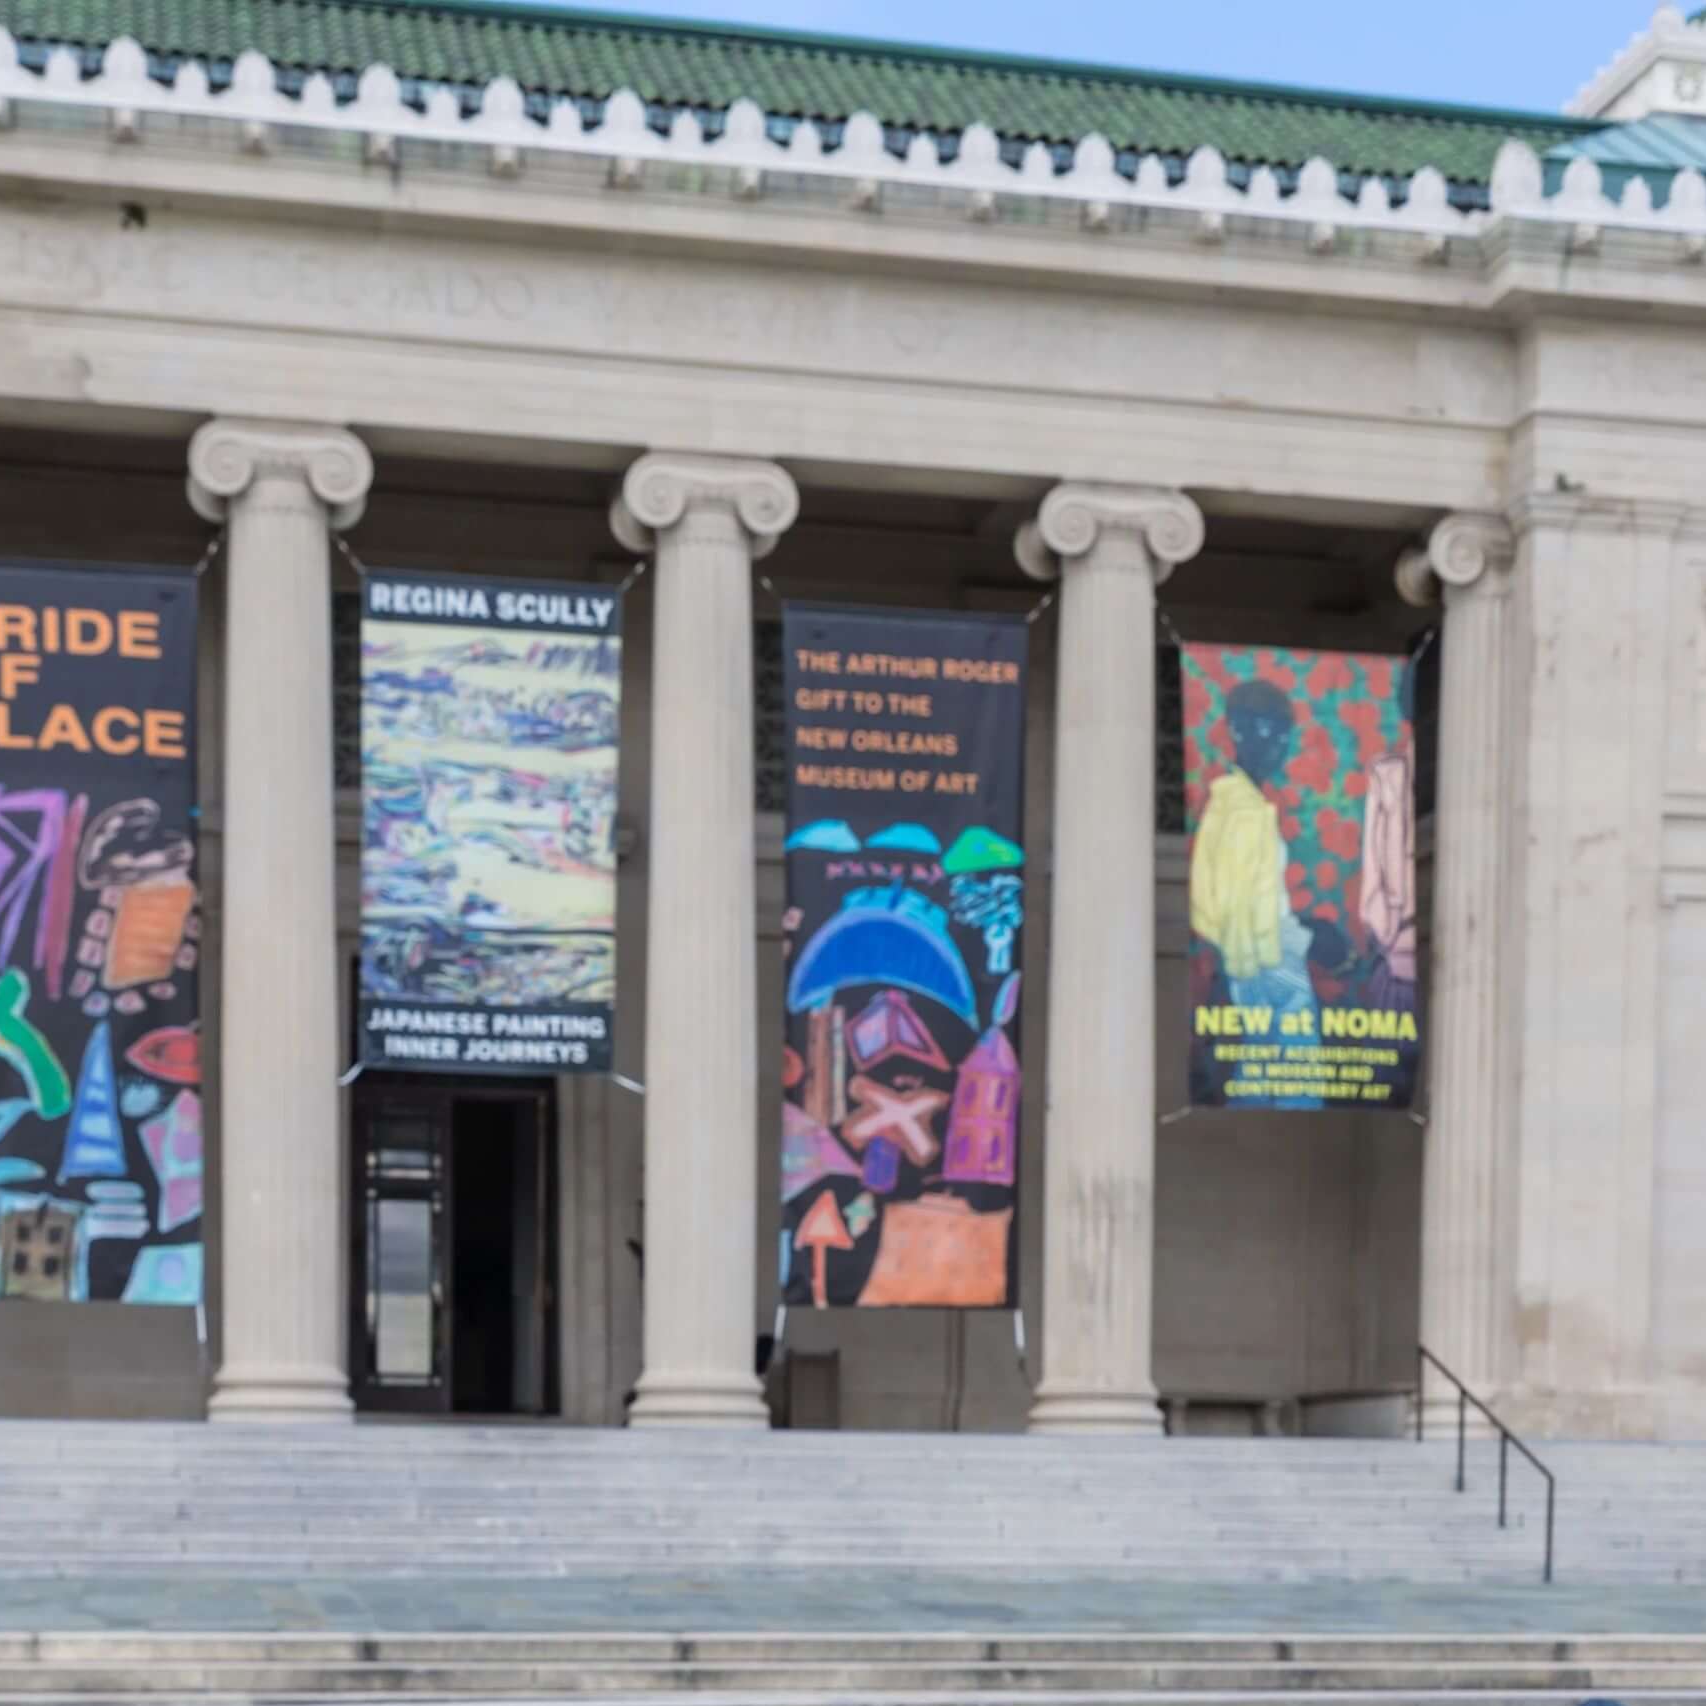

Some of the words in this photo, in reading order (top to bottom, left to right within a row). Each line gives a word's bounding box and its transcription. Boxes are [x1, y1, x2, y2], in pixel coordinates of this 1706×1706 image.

[369, 582, 490, 619] REGINA
[496, 592, 614, 629] SCULLY
[796, 648, 841, 675] THE
[845, 652, 938, 680] ARTHUR
[942, 657, 1020, 685] ROGER
[795, 687, 846, 713] GIFT
[853, 691, 884, 715] TO
[888, 694, 933, 718] THE
[796, 726, 847, 750] NEW
[851, 729, 959, 758] ORLEANS
[796, 765, 896, 792] MUSEUM
[899, 770, 929, 794] OF
[933, 771, 981, 796] ART
[367, 1007, 487, 1036] JAPANESE
[492, 1014, 607, 1039] PAINTING
[1194, 1004, 1273, 1036] NEW
[1279, 1010, 1316, 1036] at
[1321, 1007, 1419, 1041] NOMA
[384, 1034, 459, 1060] INNER
[463, 1040, 589, 1065] JOURNEYS
[1214, 1044, 1280, 1061] RECENT
[1285, 1047, 1398, 1065] ACQUISITIONS
[1242, 1062, 1262, 1079] IN
[1266, 1064, 1336, 1079] MODERN
[1339, 1066, 1374, 1081] AND
[1224, 1081, 1357, 1098] CONTEMPORARY
[1361, 1084, 1392, 1100] ART
